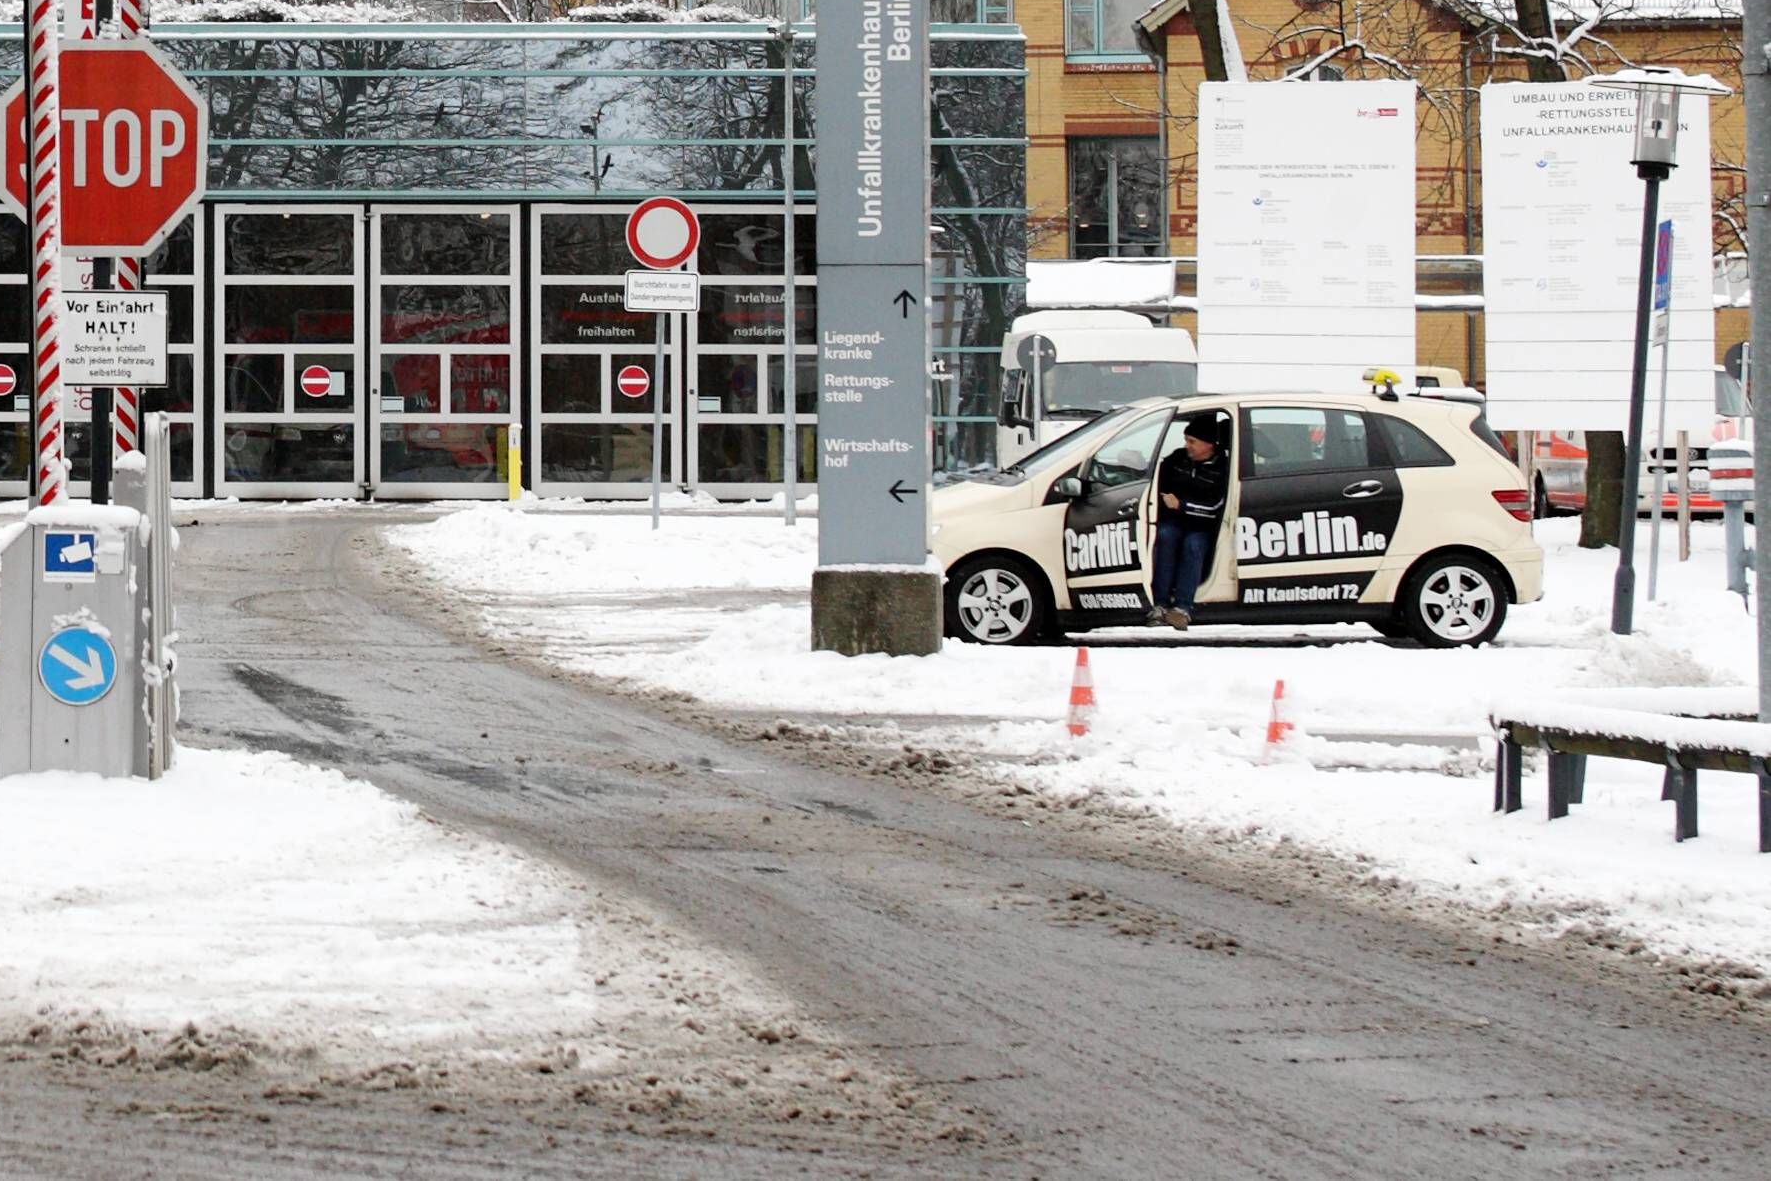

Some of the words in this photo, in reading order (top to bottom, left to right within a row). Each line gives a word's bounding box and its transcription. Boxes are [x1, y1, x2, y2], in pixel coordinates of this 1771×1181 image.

[1512, 91, 1556, 104] UMBAU
[1559, 91, 1585, 103] UND
[1588, 90, 1639, 101] ERWEITE
[1536, 106, 1635, 120] -RETTUNGSSTEL
[20, 108, 186, 188] TOP
[579, 291, 625, 304] Ausfah
[66, 300, 89, 314] Vor
[85, 320, 136, 335] HALT!
[578, 324, 635, 337] freihalten
[824, 330, 885, 347] Liegend-
[824, 346, 873, 360] kranke
[65, 356, 85, 365] nach
[89, 356, 114, 366] jedem
[117, 356, 155, 367] Fahrzeug
[824, 373, 895, 389] Rettungs-
[824, 388, 863, 402] stelle
[824, 438, 914, 453] Wirtschafts-
[824, 453, 849, 467] hof
[1064, 522, 1138, 571] CarHifi-
[1237, 510, 1386, 560] Berlin.de
[1243, 588, 1265, 604] Alt
[1266, 585, 1339, 603] Kaulsdorf
[1341, 583, 1359, 601] 72
